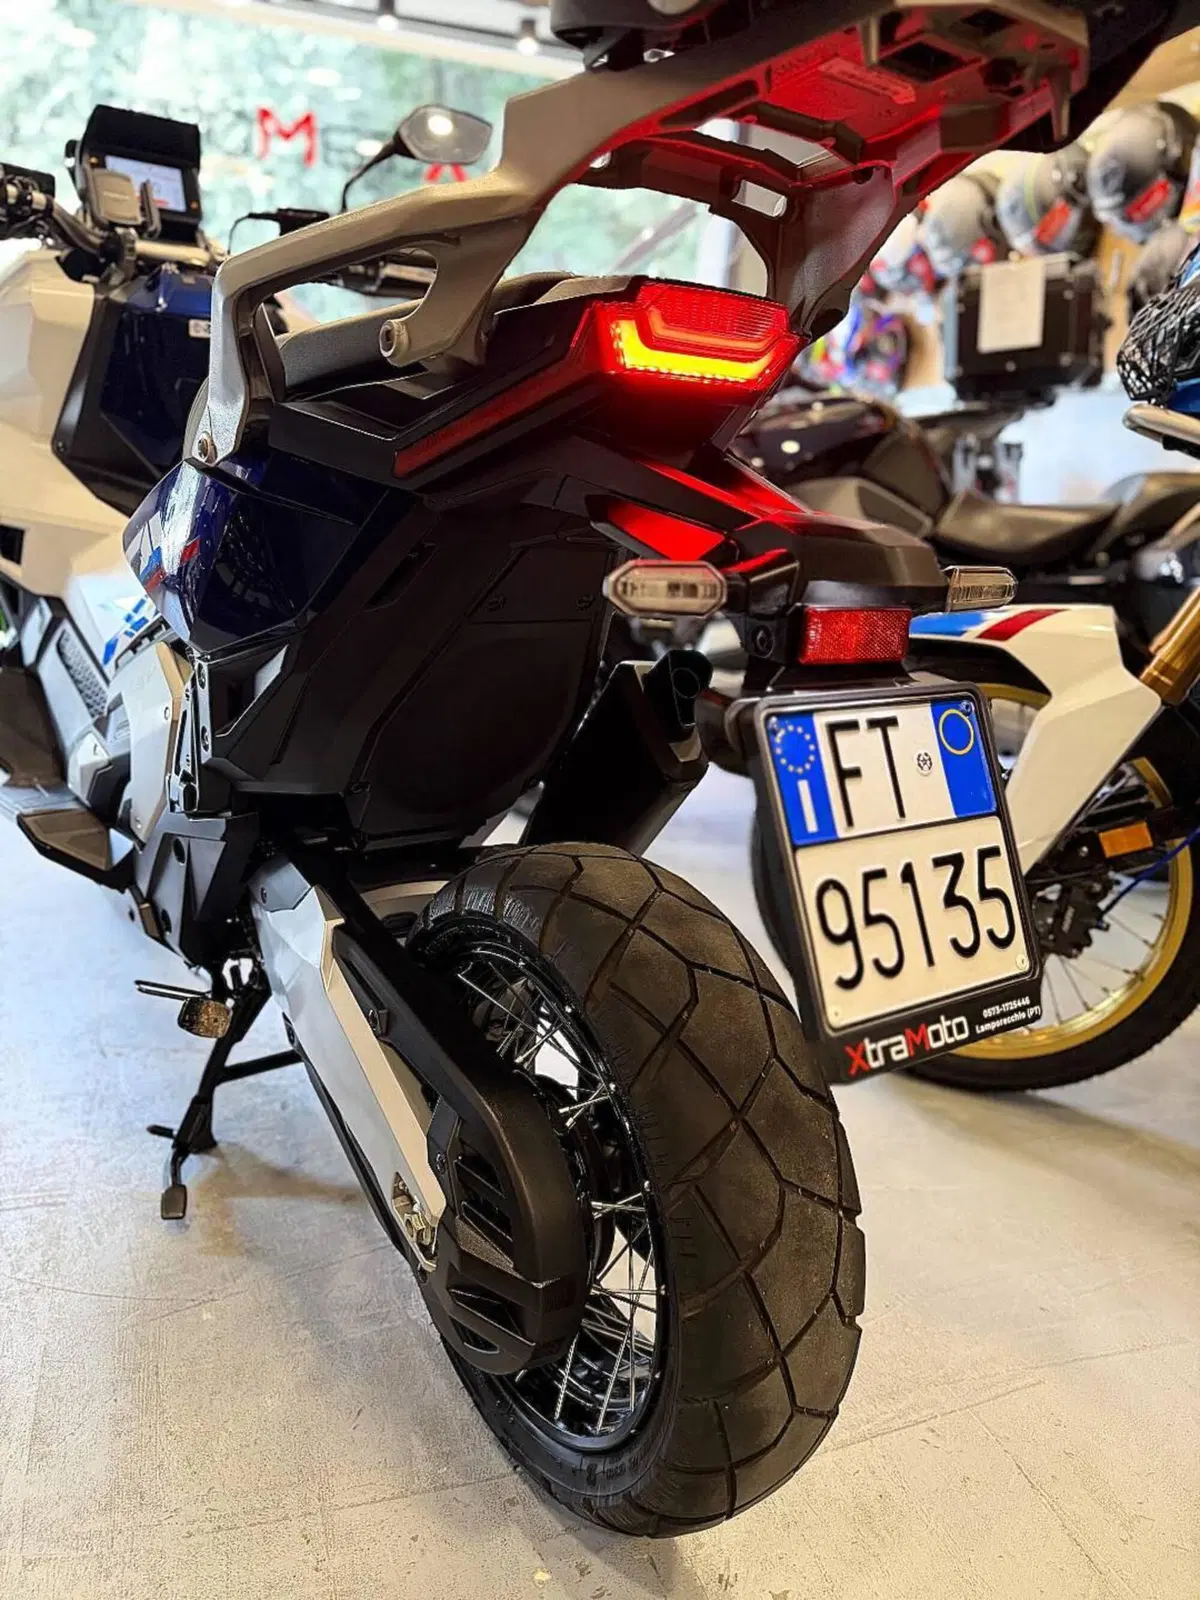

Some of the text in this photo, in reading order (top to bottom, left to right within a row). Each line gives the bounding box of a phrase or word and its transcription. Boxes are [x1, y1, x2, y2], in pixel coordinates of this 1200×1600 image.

[824, 715, 906, 828] FT
[815, 844, 1016, 990] 95135
[845, 1015, 969, 1076] XtraMoto
[975, 1005, 1041, 1034] Lamporecchio (PT)
